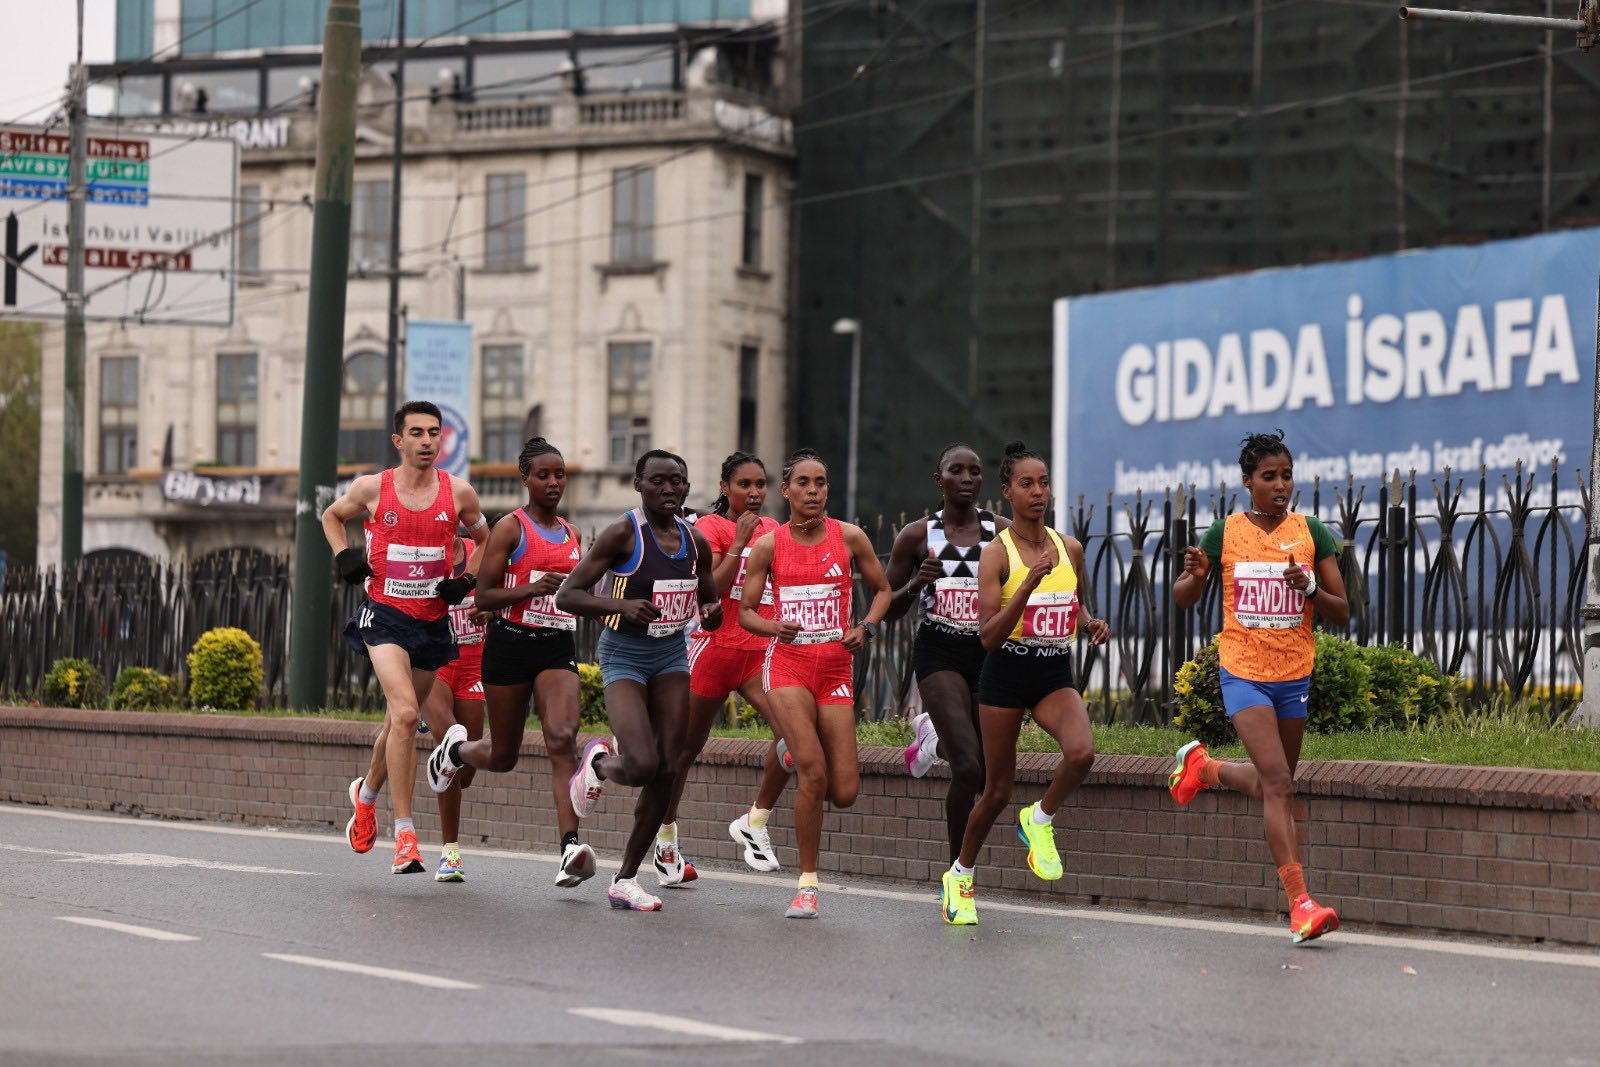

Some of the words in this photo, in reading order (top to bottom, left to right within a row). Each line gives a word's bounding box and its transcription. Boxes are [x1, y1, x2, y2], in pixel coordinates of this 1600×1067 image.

[1, 132, 148, 159] Sultanhmet
[1, 157, 69, 179] Avrasy
[42, 217, 139, 242] İstnbul
[43, 247, 118, 268] Kaalı
[1115, 323, 1334, 426] GIDADA
[1345, 293, 1581, 405] İSRAFA
[164, 471, 261, 506] Biryani
[408, 564, 425, 577] 24
[391, 587, 430, 597] MARATHON
[392, 580, 417, 588] ISTANBUL
[1032, 605, 1073, 636] GETE
